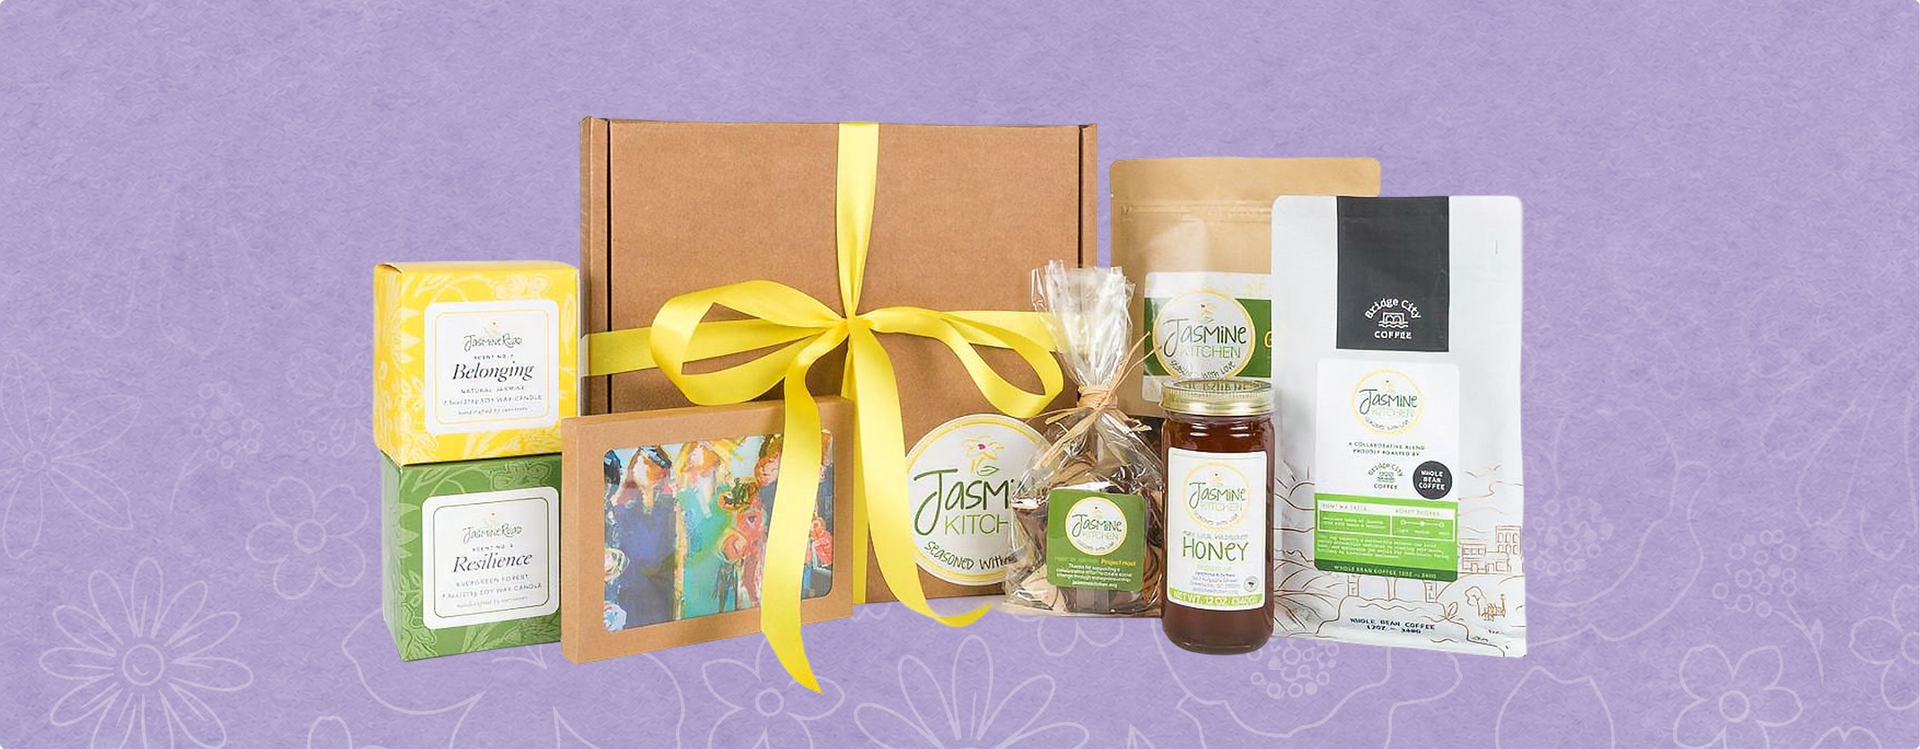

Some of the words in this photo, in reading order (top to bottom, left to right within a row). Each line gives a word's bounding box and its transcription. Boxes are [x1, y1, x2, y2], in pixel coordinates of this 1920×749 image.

[1364, 298, 1399, 319] Bridge
[1401, 299, 1422, 318] City
[1373, 330, 1412, 339] COFFEE
[1182, 345, 1241, 359] ITCHEN
[452, 360, 535, 383] Belonging
[515, 394, 542, 402] CANDLE
[1354, 441, 1403, 450] COLLABORATIVE
[1420, 470, 1444, 478] WHOLE
[1422, 476, 1442, 484] BEAN
[1418, 482, 1446, 491] COFFEE
[913, 468, 1015, 536] Jasm
[944, 513, 1009, 536] KITCH
[1182, 535, 1249, 562] HONEY
[453, 552, 533, 573] Resilience
[501, 572, 529, 582] FOREST
[1374, 568, 1397, 576] COFFEE
[514, 582, 542, 592] CANDLE
[1349, 617, 1375, 625] WHOLE
[1379, 619, 1401, 627] BEAN
[1404, 621, 1436, 630] COFFEE
